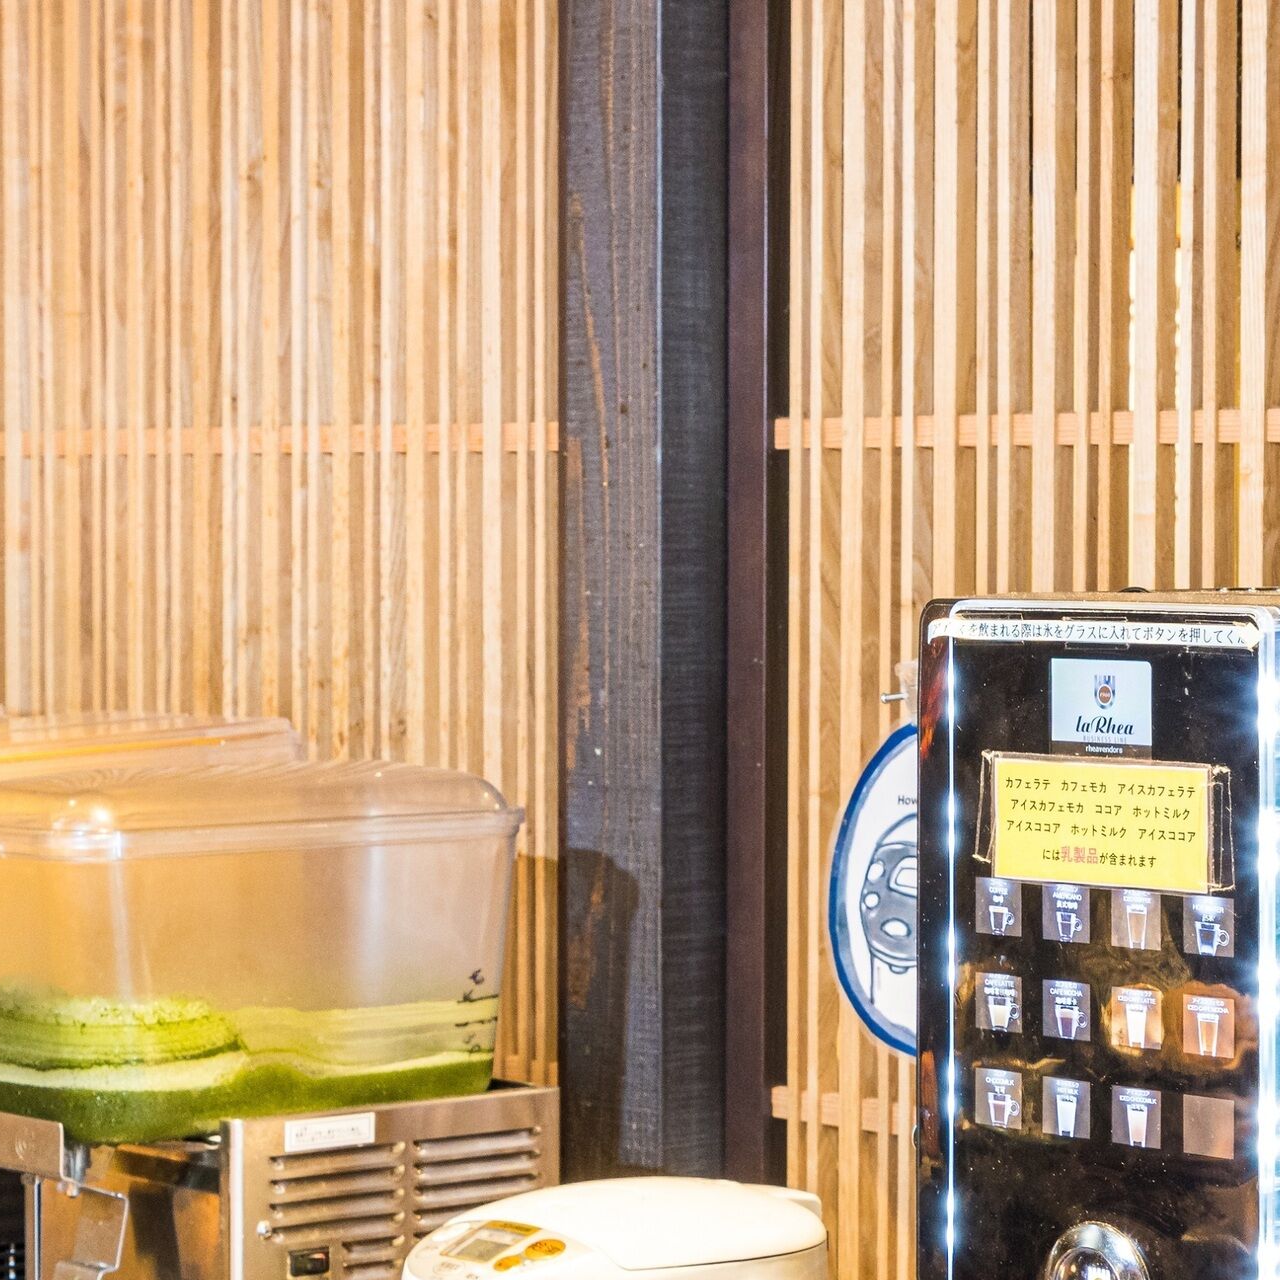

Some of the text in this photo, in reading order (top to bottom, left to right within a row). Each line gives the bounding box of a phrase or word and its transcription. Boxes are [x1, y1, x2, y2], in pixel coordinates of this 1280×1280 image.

[1005, 776, 1195, 799] カフェラテ カフェモカ アイスカフェラテ
[1010, 799, 1190, 820] アイスカフェモカ ココア ホットミルク
[1006, 819, 1196, 843] アイスココア ホットミルク アイスココア
[1042, 846, 1157, 868] には乳製品が含まれます
